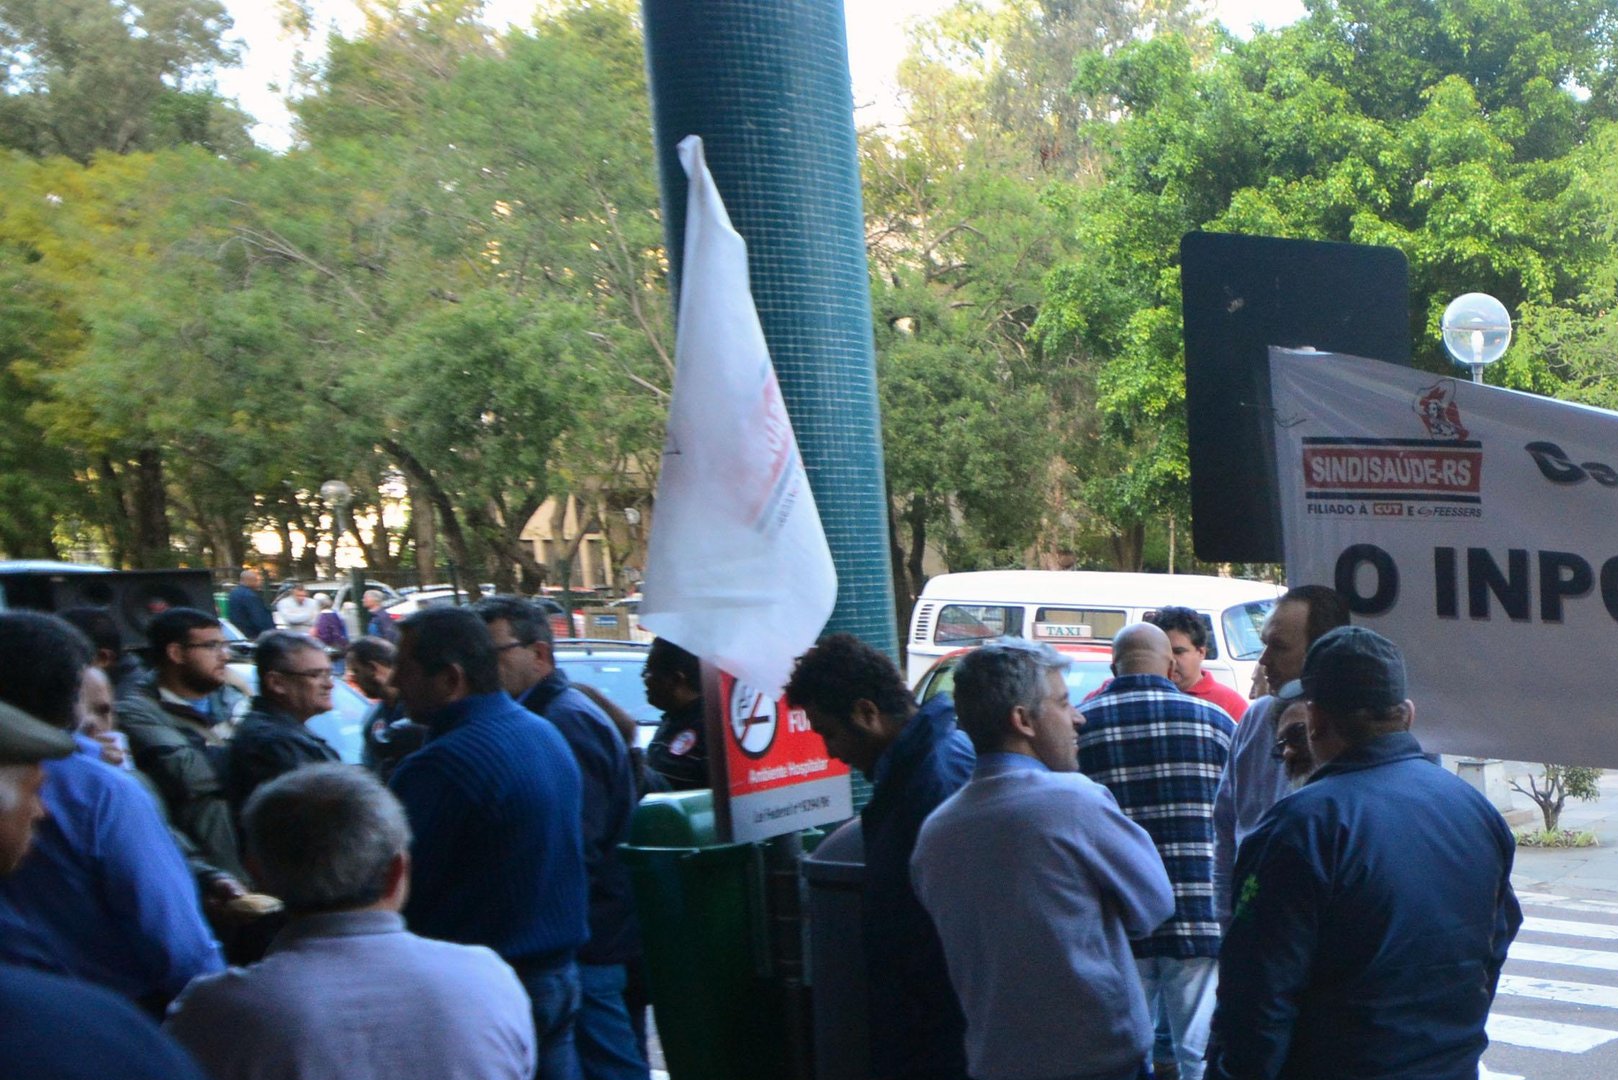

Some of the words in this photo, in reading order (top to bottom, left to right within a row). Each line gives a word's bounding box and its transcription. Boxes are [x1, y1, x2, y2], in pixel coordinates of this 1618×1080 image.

[1311, 452, 1472, 486] SINDISAÚDE-RS
[1307, 503, 1355, 515] FILIADO
[1359, 502, 1368, 515] À
[1375, 504, 1402, 514] CUT
[1408, 506, 1414, 516] E
[1433, 507, 1482, 517] FEESSERS
[1335, 543, 1399, 616] O
[1046, 626, 1081, 636] TAXI
